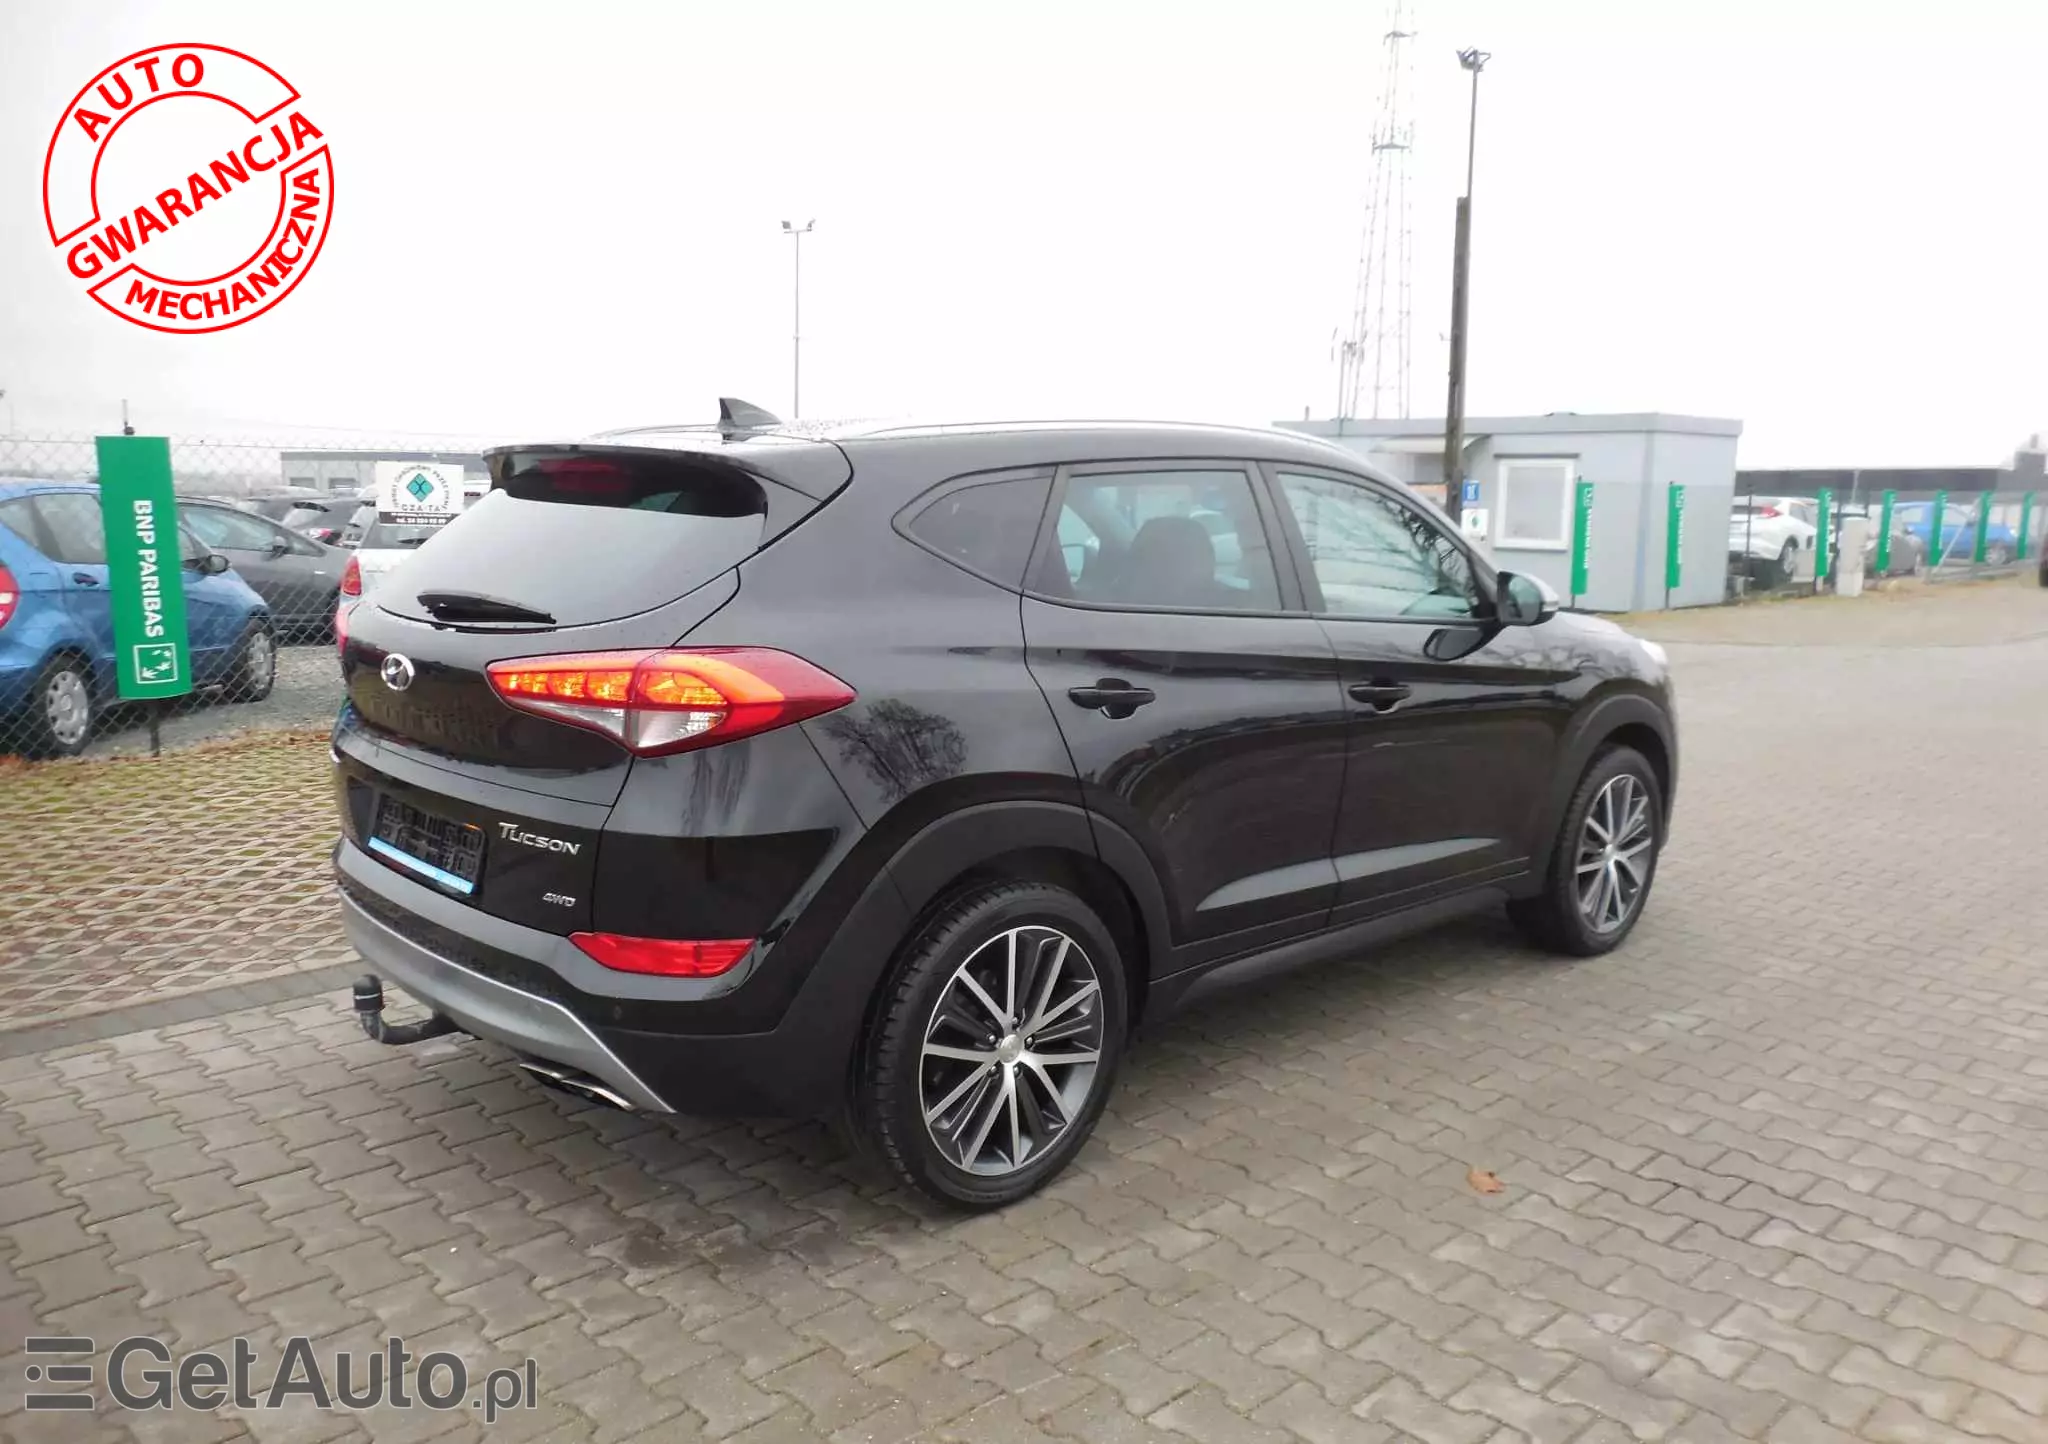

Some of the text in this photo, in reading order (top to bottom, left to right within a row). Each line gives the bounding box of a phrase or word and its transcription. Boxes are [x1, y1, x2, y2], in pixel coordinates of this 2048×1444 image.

[134, 500, 165, 637] BNP PARIBAS
[542, 893, 576, 907] 4WD
